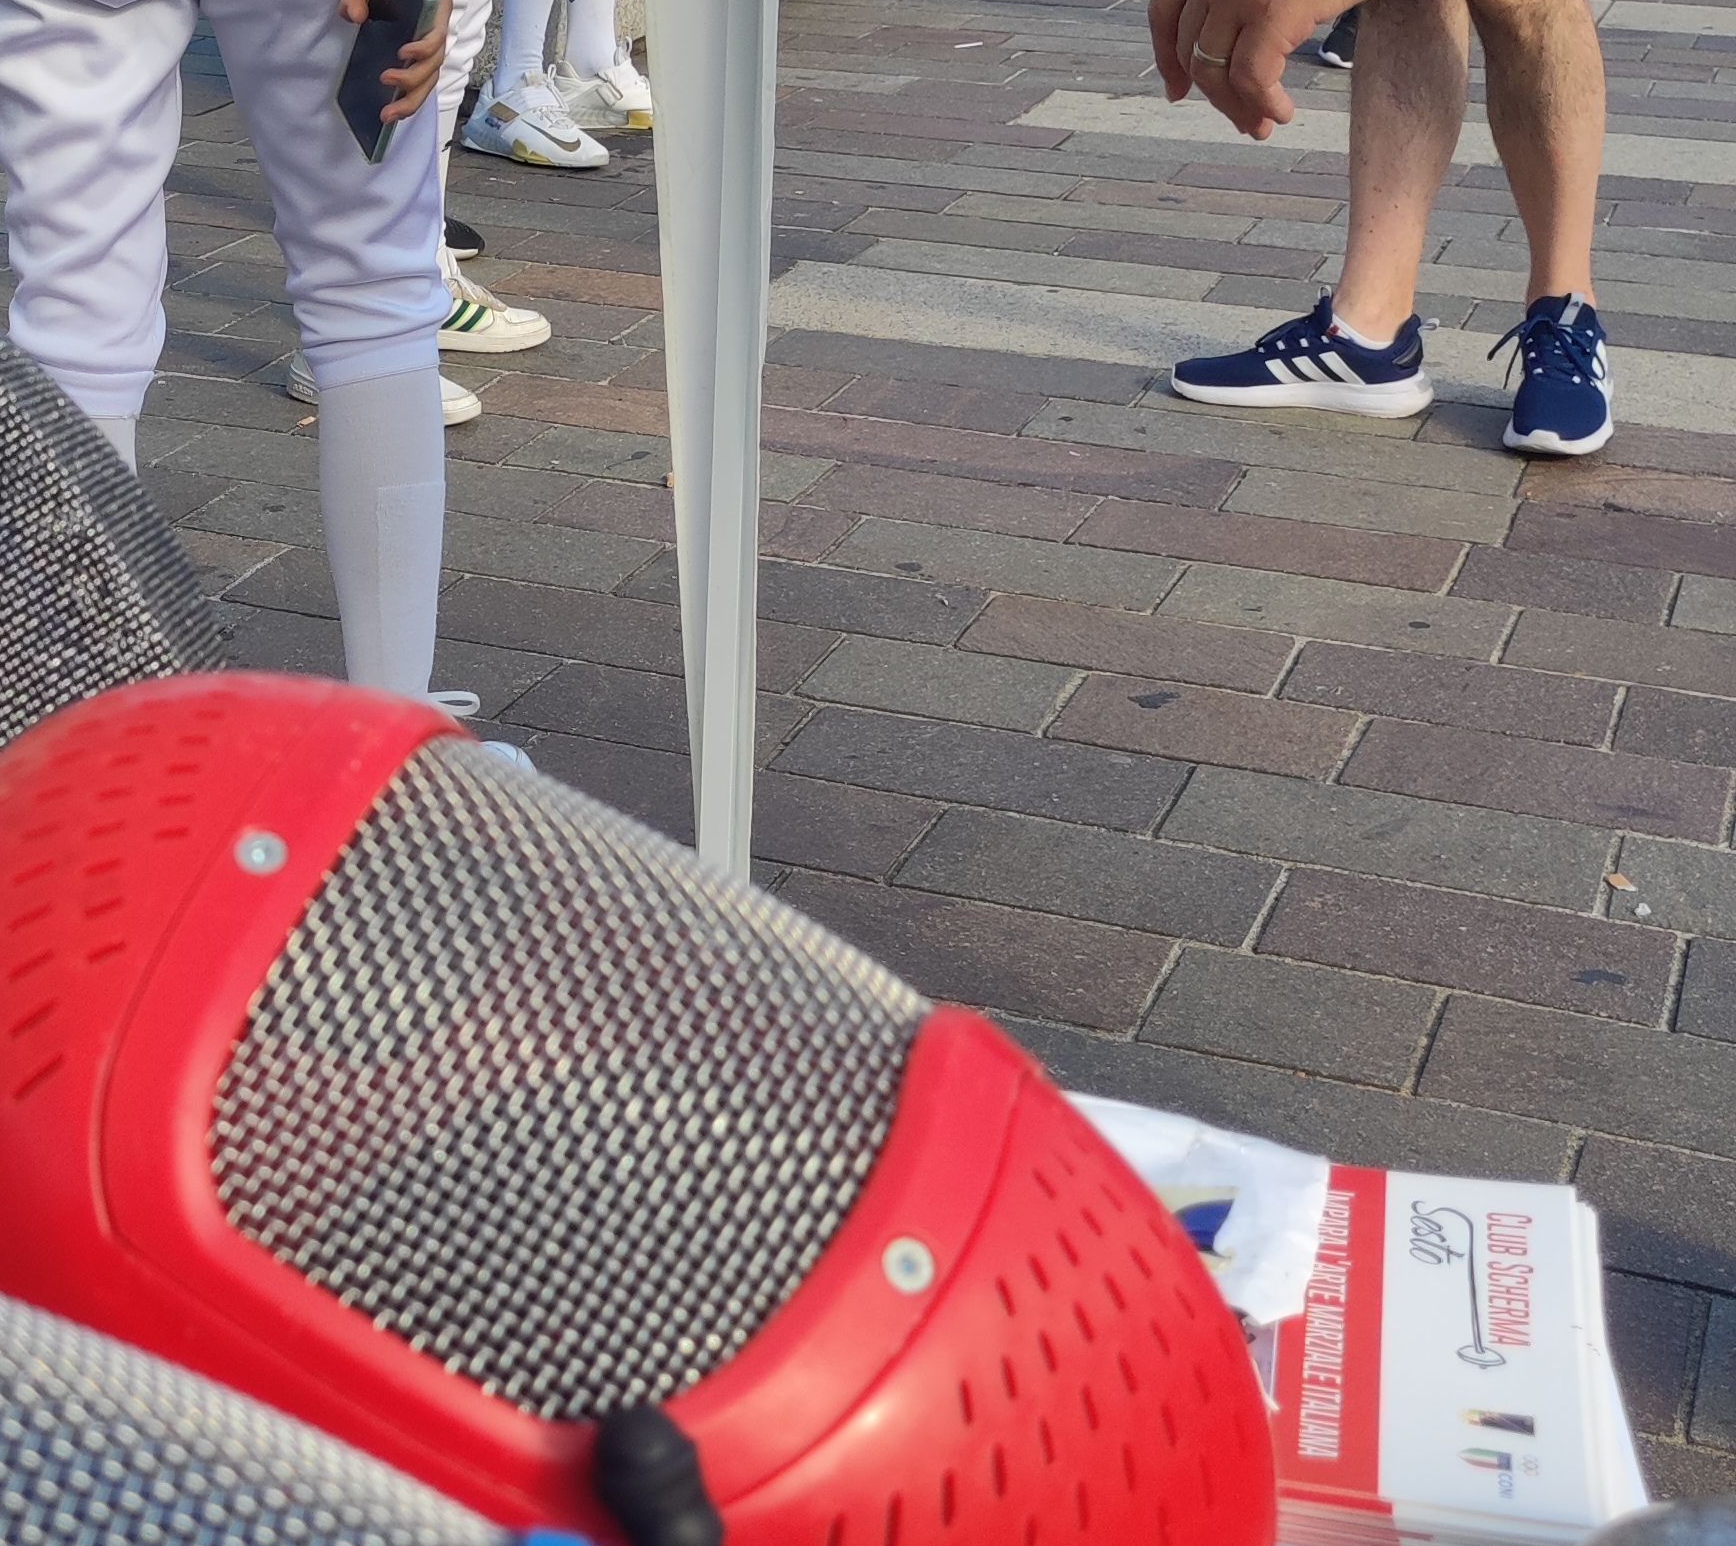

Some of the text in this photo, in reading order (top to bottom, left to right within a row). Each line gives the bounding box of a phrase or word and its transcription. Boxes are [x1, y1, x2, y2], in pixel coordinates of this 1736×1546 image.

[1409, 1200, 1473, 1265] Sesto
[1486, 1212, 1534, 1347] CLUB SCHERMA
[1302, 1302, 1344, 1385] MARZIALE
[1297, 1383, 1340, 1458] ITALIANA
[1498, 1473, 1513, 1499] CONI
